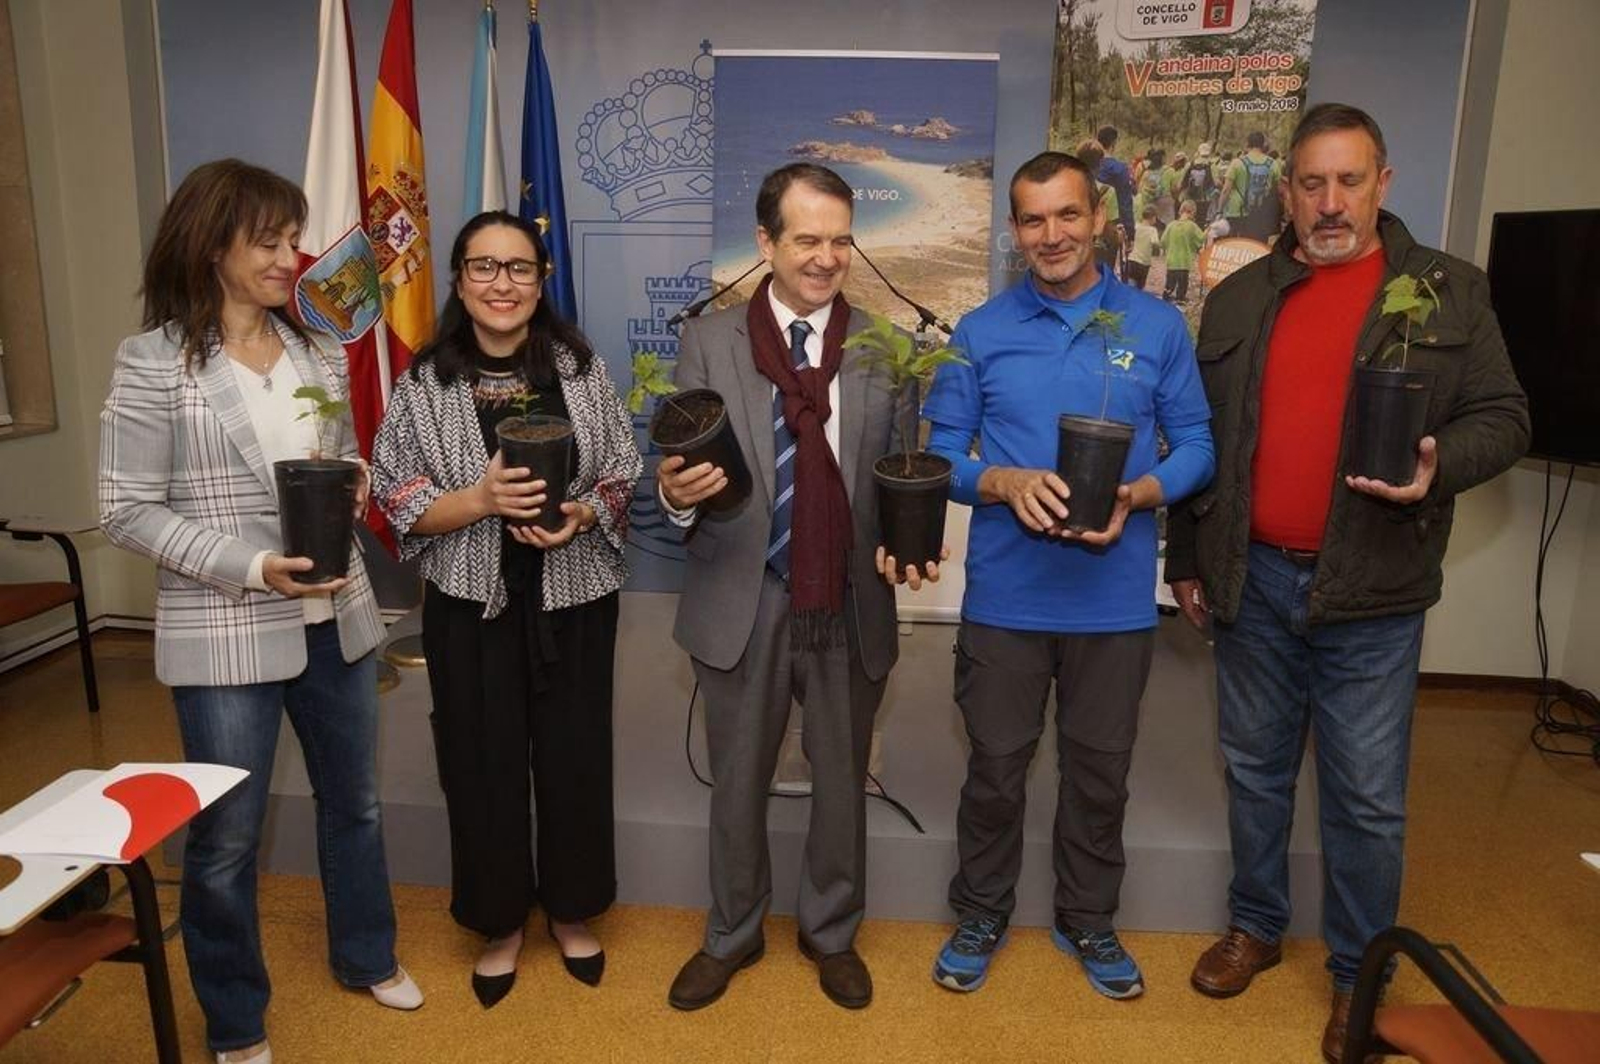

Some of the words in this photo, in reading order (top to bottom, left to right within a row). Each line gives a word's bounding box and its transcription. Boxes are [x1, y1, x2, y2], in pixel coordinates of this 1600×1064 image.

[1137, 3, 1196, 15] CONCELLO
[1143, 16, 1158, 25] DE
[1161, 14, 1188, 24] VIGO
[1125, 60, 1153, 97] V
[1157, 54, 1234, 75] andaina
[1235, 51, 1294, 75] polos
[1146, 77, 1224, 97] montes
[1226, 73, 1253, 94] de
[1257, 73, 1302, 96] vigo
[1221, 100, 1235, 112] 13
[1236, 99, 1268, 112] maio
[1270, 97, 1299, 111] 2018
